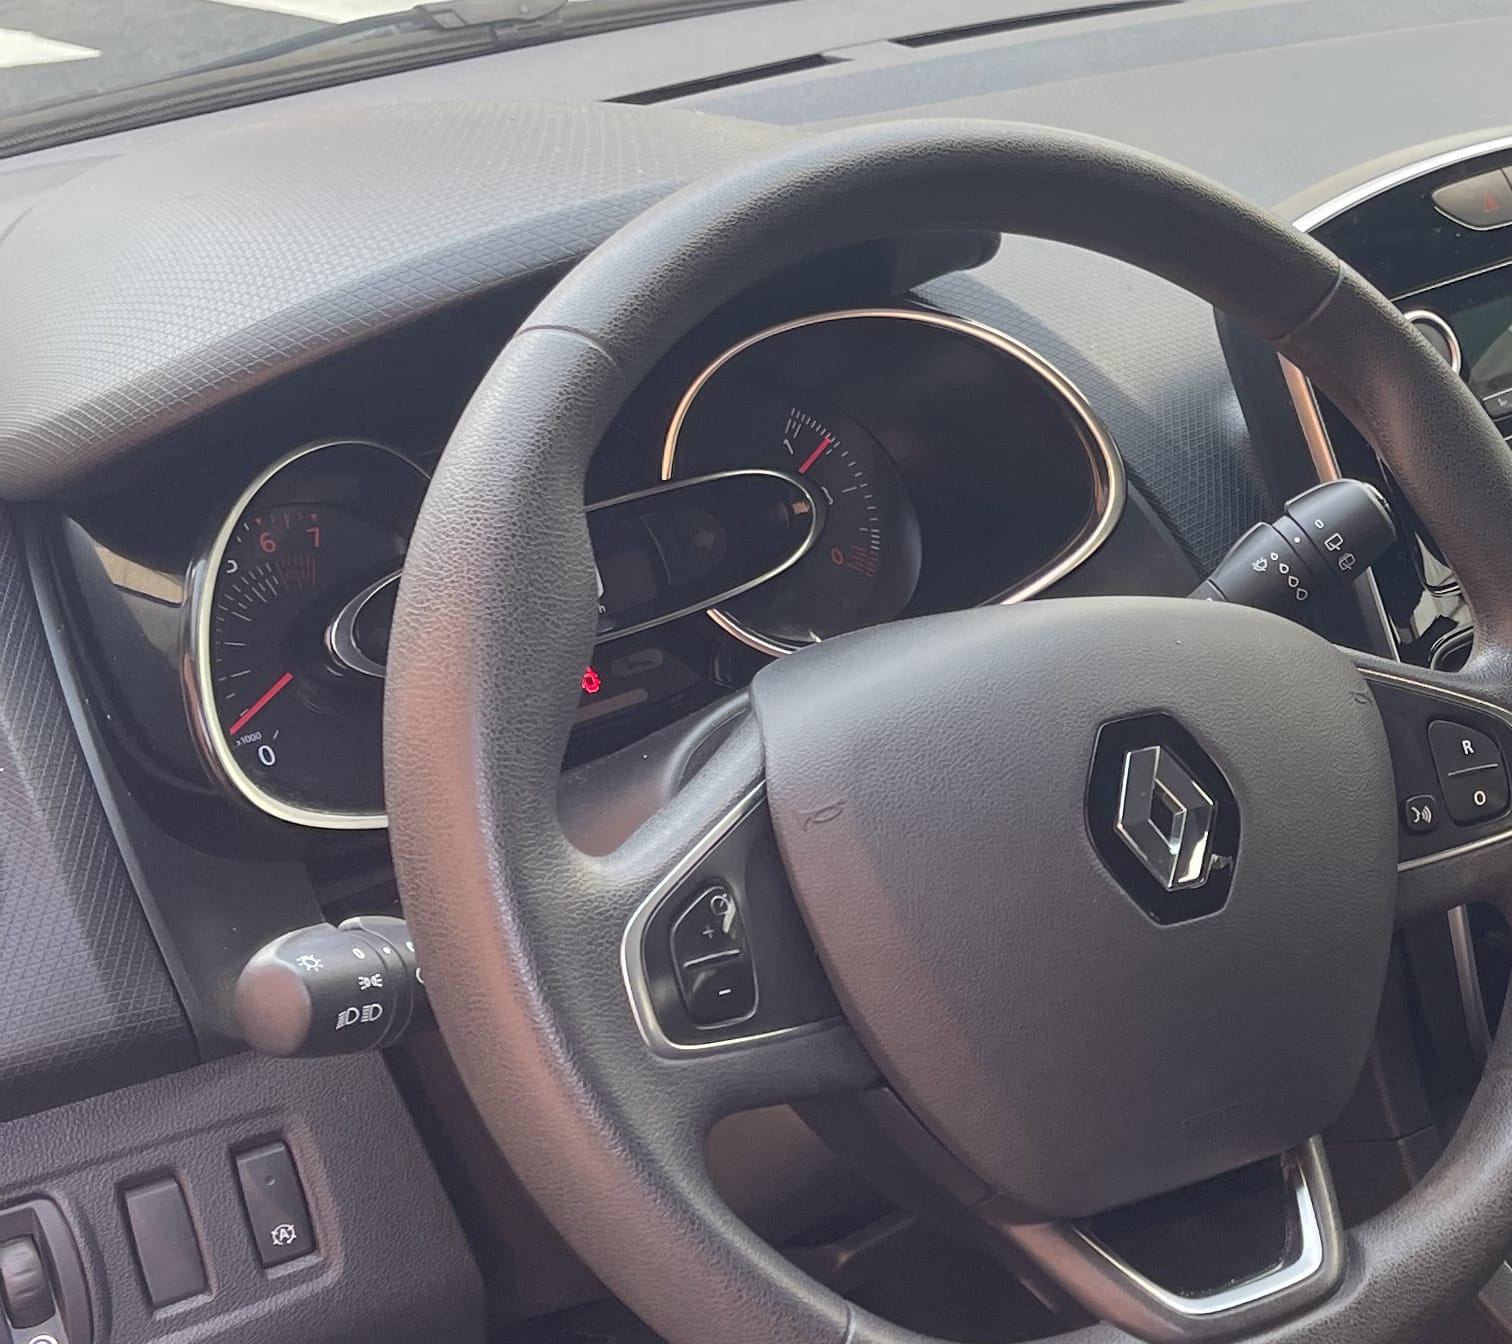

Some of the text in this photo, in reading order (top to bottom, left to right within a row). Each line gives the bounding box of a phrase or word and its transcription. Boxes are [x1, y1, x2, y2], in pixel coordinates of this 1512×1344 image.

[259, 527, 320, 553] 6 7
[235, 731, 263, 747] x1000
[1461, 739, 1475, 755] R
[258, 744, 276, 766] 0
